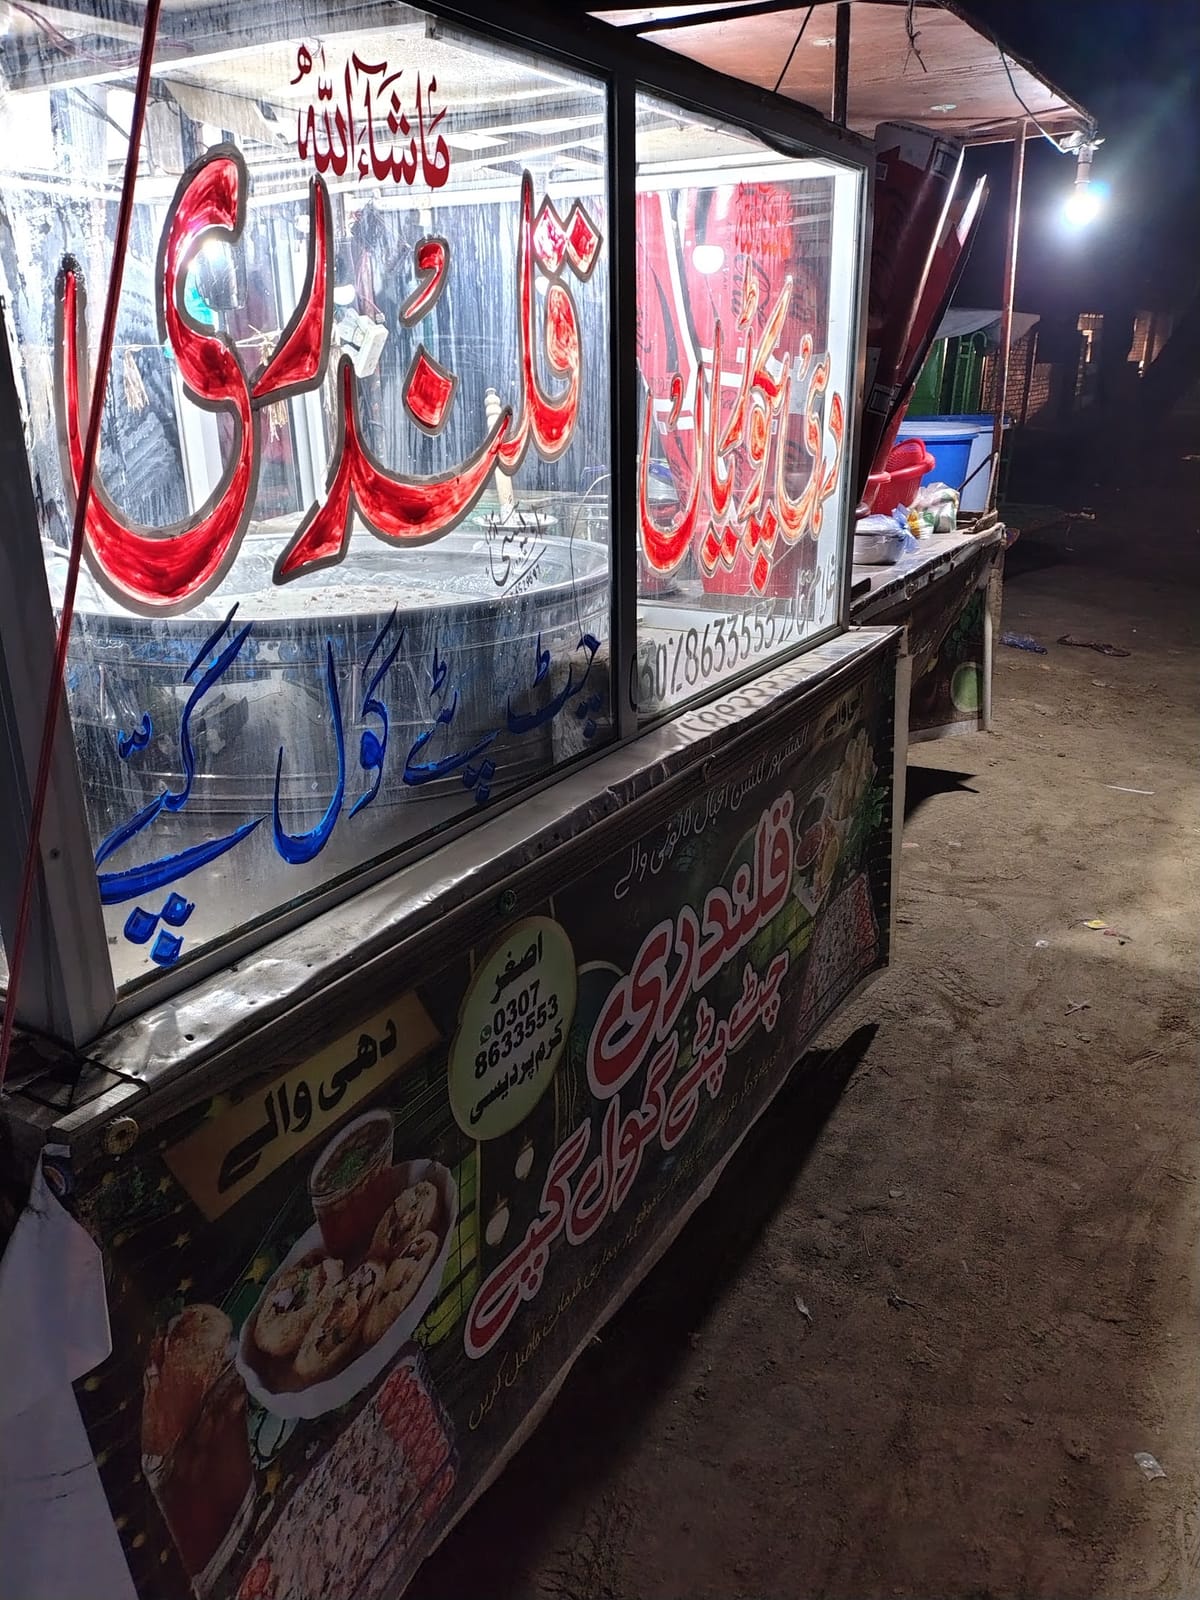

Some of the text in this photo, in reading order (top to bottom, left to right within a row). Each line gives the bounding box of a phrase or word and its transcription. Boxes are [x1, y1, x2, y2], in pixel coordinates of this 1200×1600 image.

[55, 142, 603, 618] قلندری
[272, 601, 406, 865] گول
[587, 791, 794, 1099] قلندری
[613, 841, 649, 900] والے
[475, 994, 559, 1079] 8633553
[490, 931, 543, 1004] اصغر
[493, 979, 540, 1036] 0307
[217, 1079, 313, 1194] والے
[565, 1043, 679, 1243] گول
[464, 1117, 590, 1360] گپے
